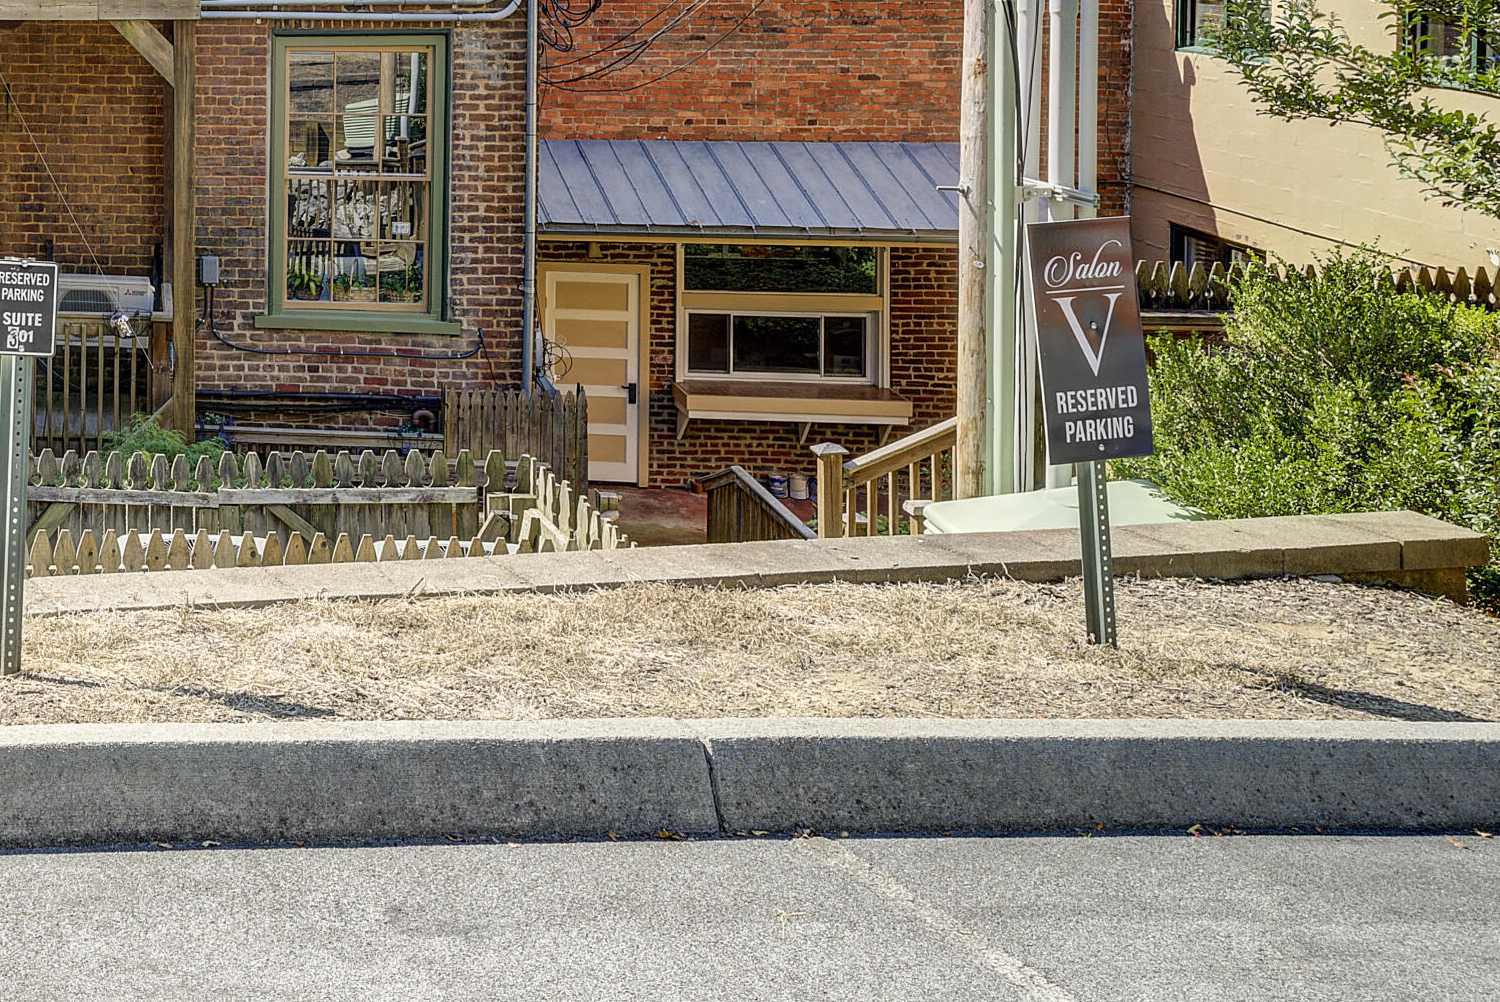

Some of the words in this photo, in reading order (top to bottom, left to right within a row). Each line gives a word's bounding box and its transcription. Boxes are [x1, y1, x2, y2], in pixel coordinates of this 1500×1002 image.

[1044, 239, 1122, 288] Salon
[1, 287, 44, 302] PARKING
[2, 311, 42, 327] SUITE
[1051, 292, 1124, 377] V
[1055, 385, 1138, 414] RESERVED
[1065, 415, 1134, 444] PARKING
